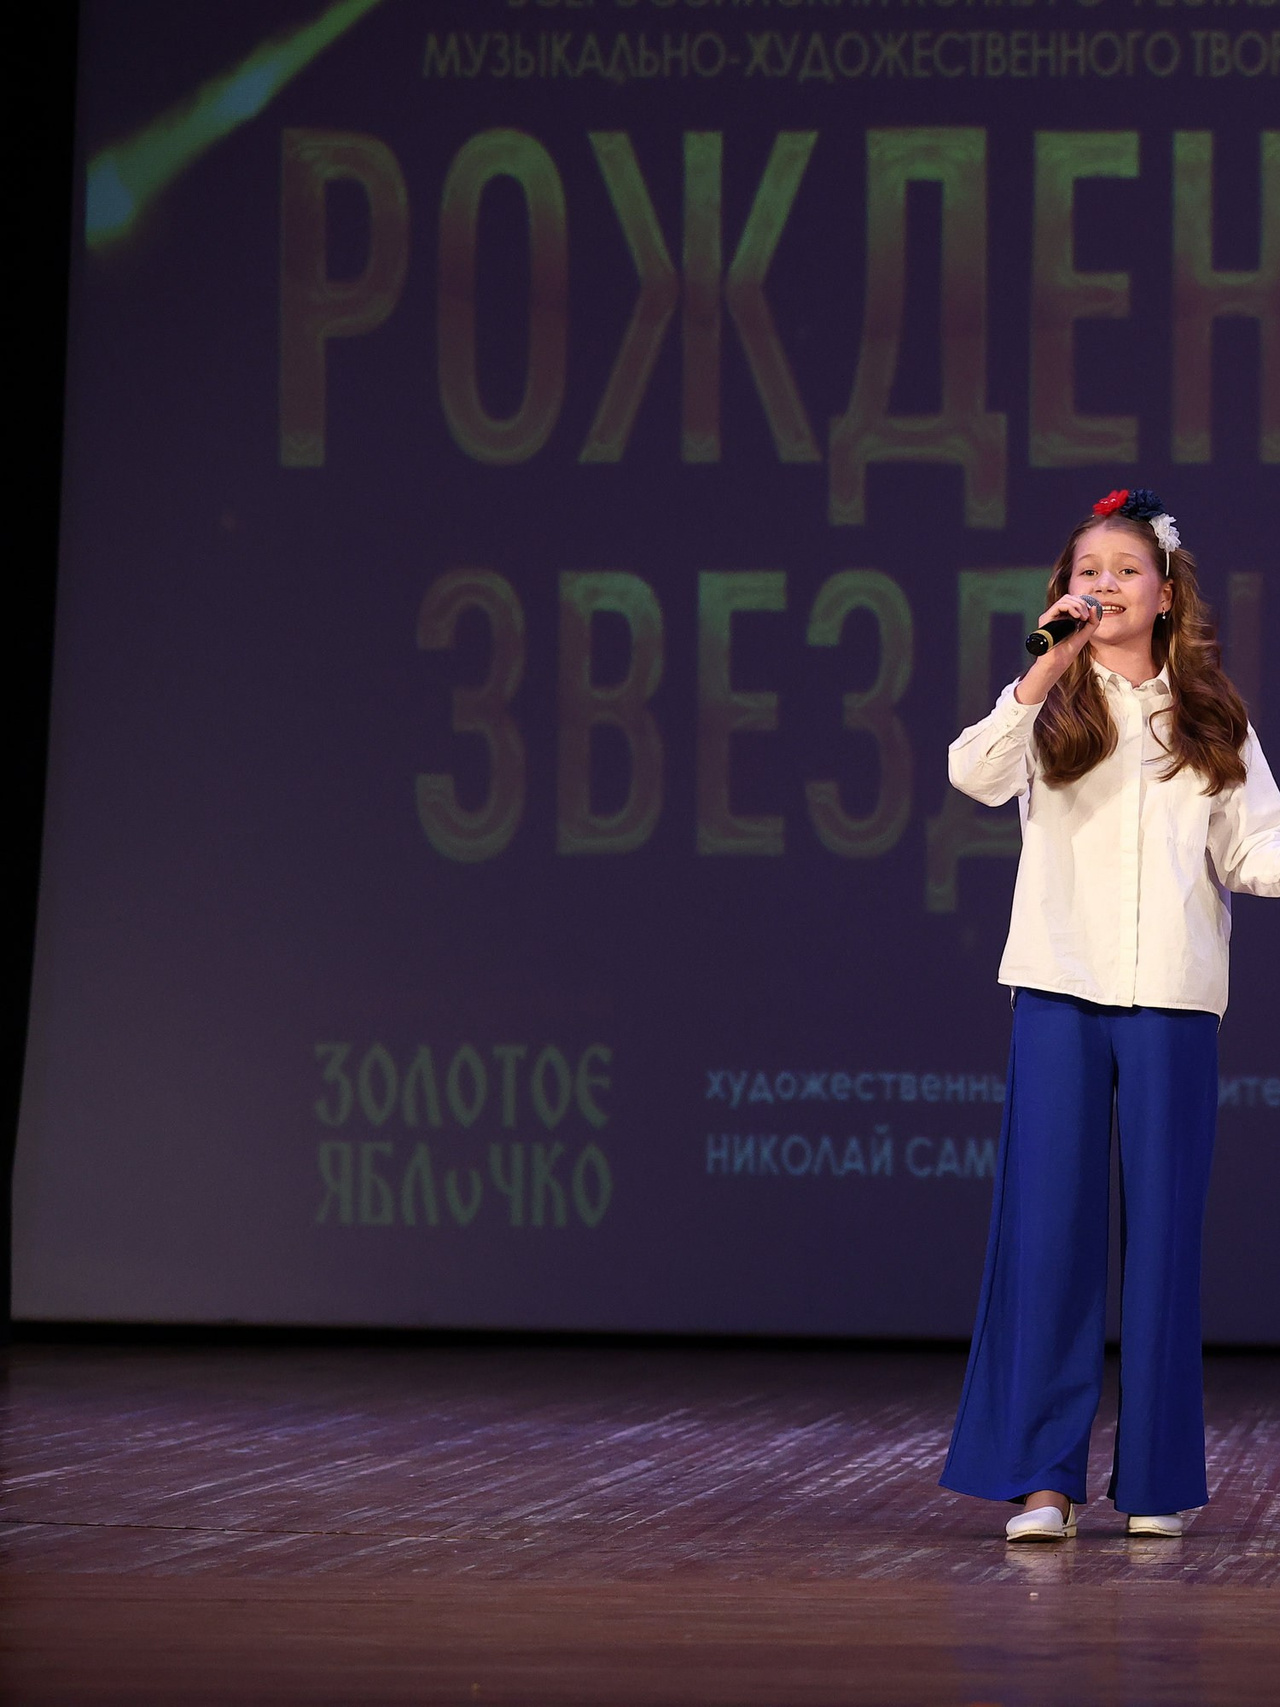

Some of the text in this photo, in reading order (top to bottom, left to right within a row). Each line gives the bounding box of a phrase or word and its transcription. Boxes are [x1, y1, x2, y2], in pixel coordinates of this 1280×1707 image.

[421, 30, 1181, 84] МУЗЫКАЛЬНО-ХУДОЖЕСТВЕННОГО
[413, 568, 1264, 914] ЗВЕЗД
[314, 1041, 613, 1130] ЗОЛОТОЕ
[704, 1069, 1006, 1109] художественны
[704, 1124, 997, 1178] НИКОЛАЙ САМ
